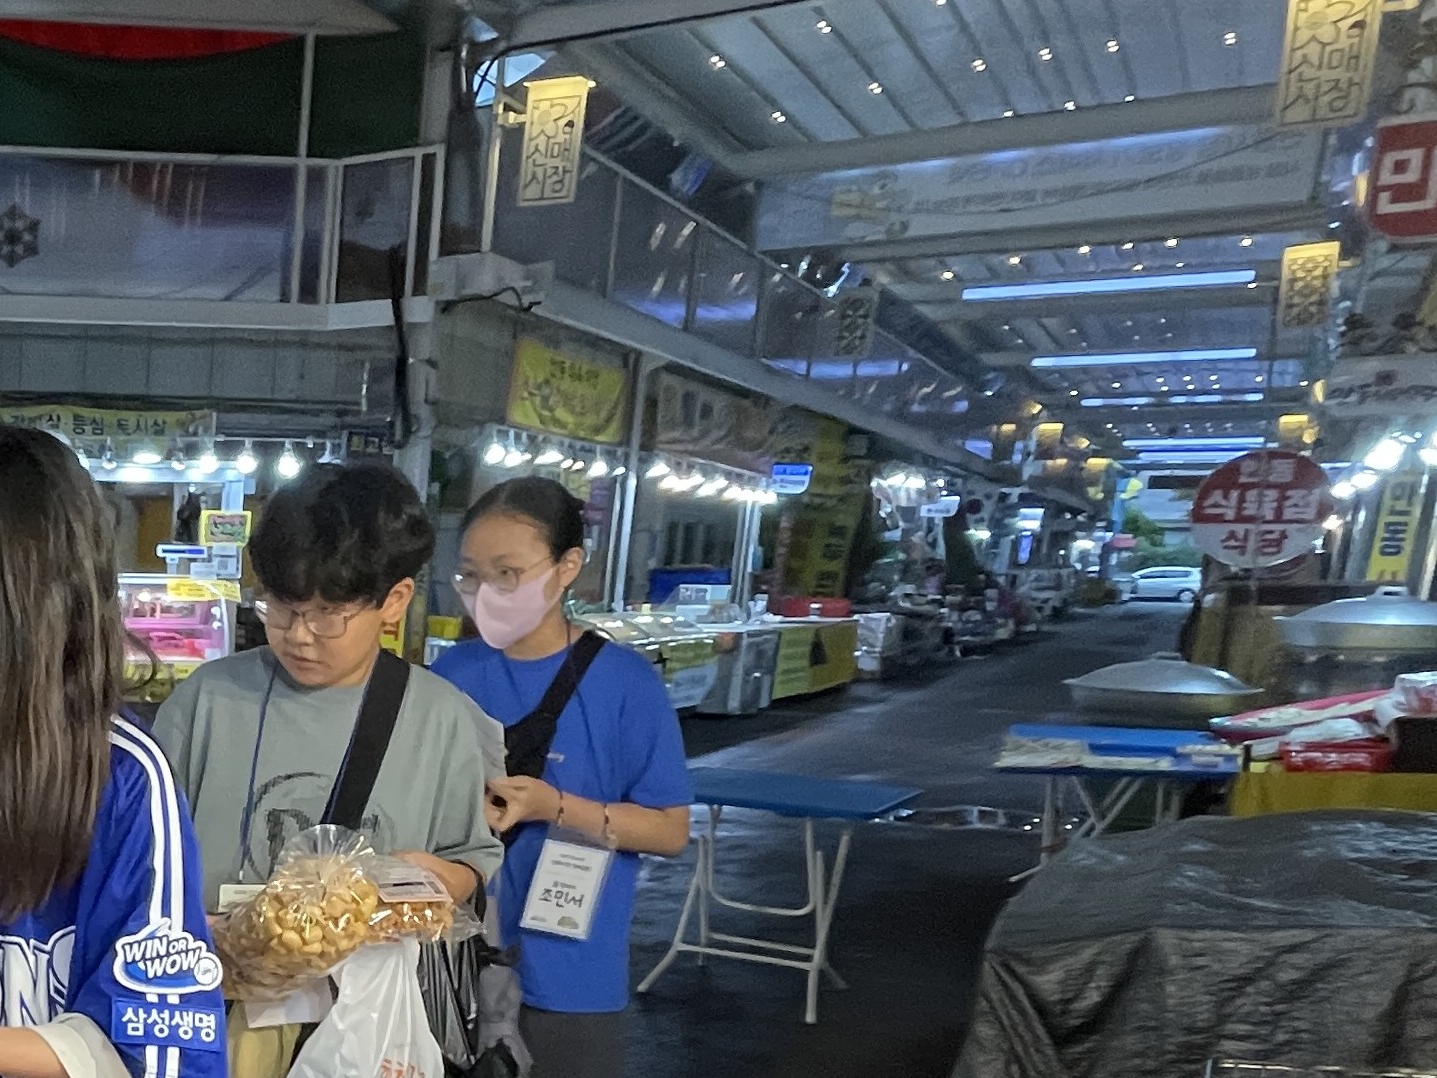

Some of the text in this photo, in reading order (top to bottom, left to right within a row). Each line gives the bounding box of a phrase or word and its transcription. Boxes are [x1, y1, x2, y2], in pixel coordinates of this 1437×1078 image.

[523, 166, 573, 198] 시장
[72, 412, 105, 435] 등심
[1202, 487, 1321, 521] 식육점
[1220, 528, 1289, 555] 식당
[538, 888, 586, 909] 조민서
[124, 938, 187, 963] WIN OR
[145, 948, 201, 978] WOW
[121, 1006, 217, 1043] 삼성생명
